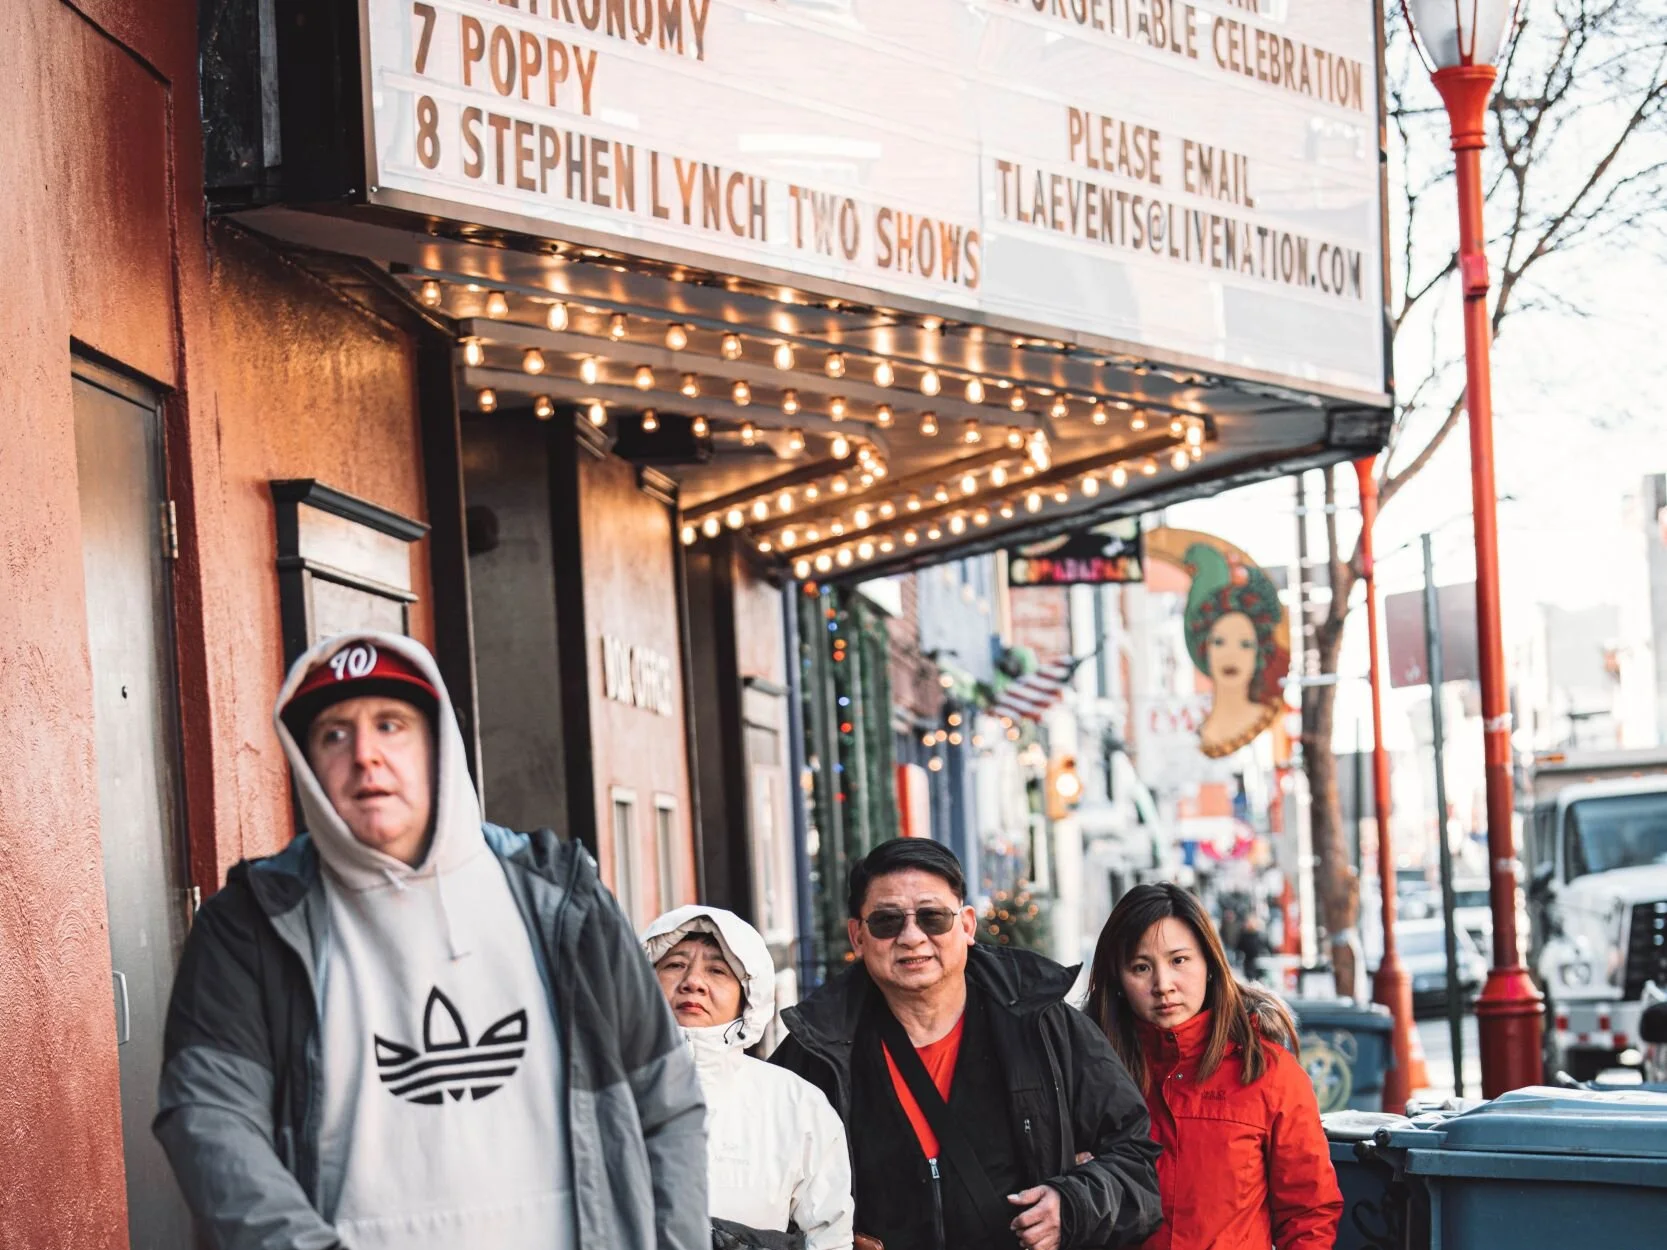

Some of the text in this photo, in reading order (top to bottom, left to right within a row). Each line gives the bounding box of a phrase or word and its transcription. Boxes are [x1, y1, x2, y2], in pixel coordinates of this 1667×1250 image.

[413, 2, 598, 117] 7 POPPY
[1212, 15, 1364, 112] CELEBRATION
[416, 95, 981, 289] 8 STEPHEN LYNCH TWO SHOWS
[1068, 106, 1254, 208] PLEASE EMAIL
